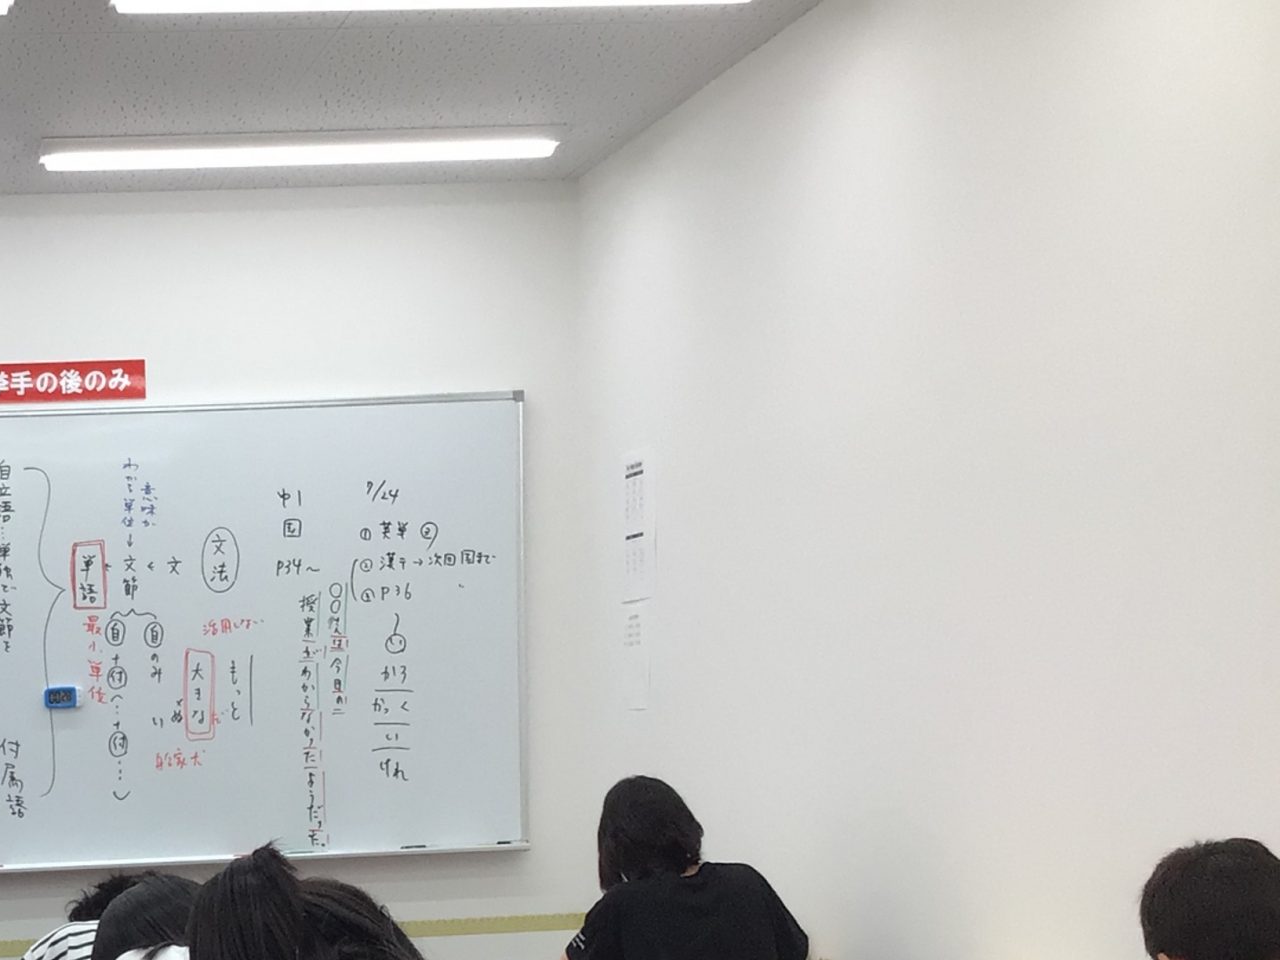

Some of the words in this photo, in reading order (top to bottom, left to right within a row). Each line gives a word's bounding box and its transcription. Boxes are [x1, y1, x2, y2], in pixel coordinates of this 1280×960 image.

[366, 480, 400, 504] 7/24
[79, 554, 98, 604] 単語
[123, 554, 138, 600] 文節
[167, 556, 182, 575] 文
[210, 533, 229, 583] 文法
[191, 663, 205, 724] 大きな
